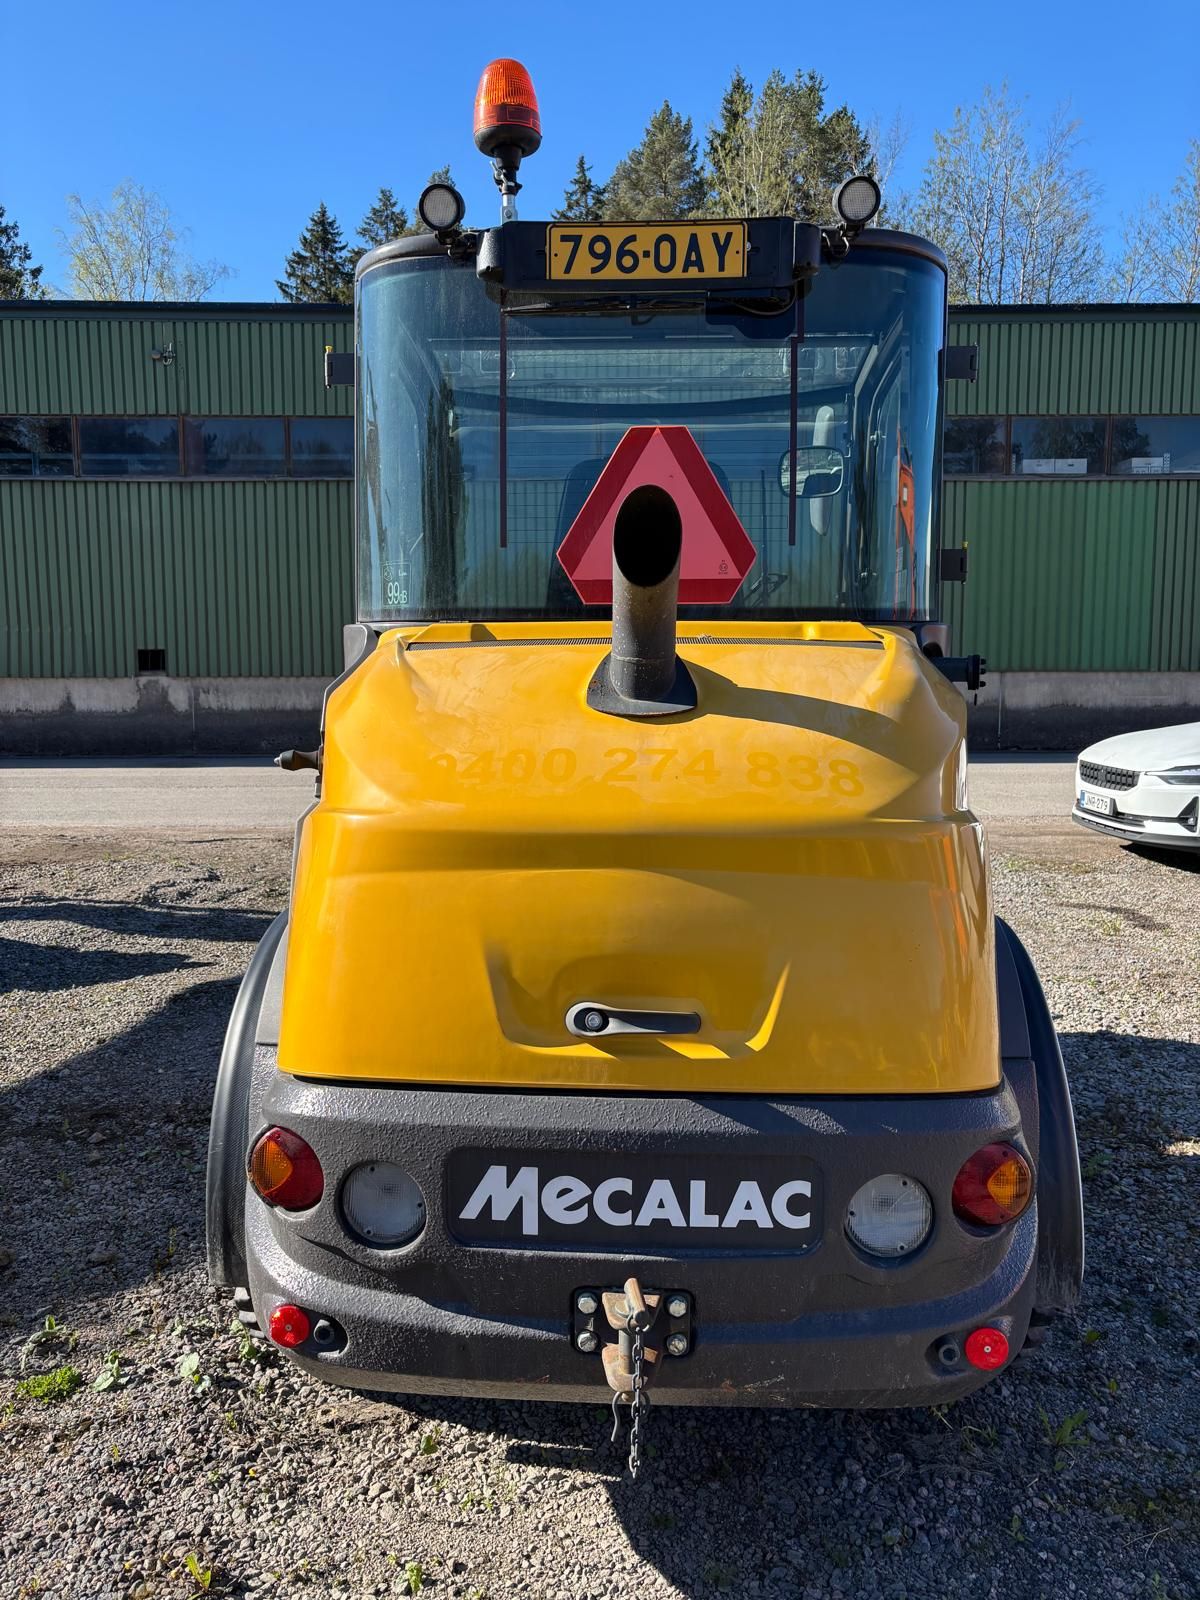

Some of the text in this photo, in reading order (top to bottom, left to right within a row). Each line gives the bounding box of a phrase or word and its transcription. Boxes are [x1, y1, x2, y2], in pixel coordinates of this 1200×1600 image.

[559, 231, 734, 274] 796-OAY
[603, 747, 721, 785] 274
[746, 751, 865, 797] 838
